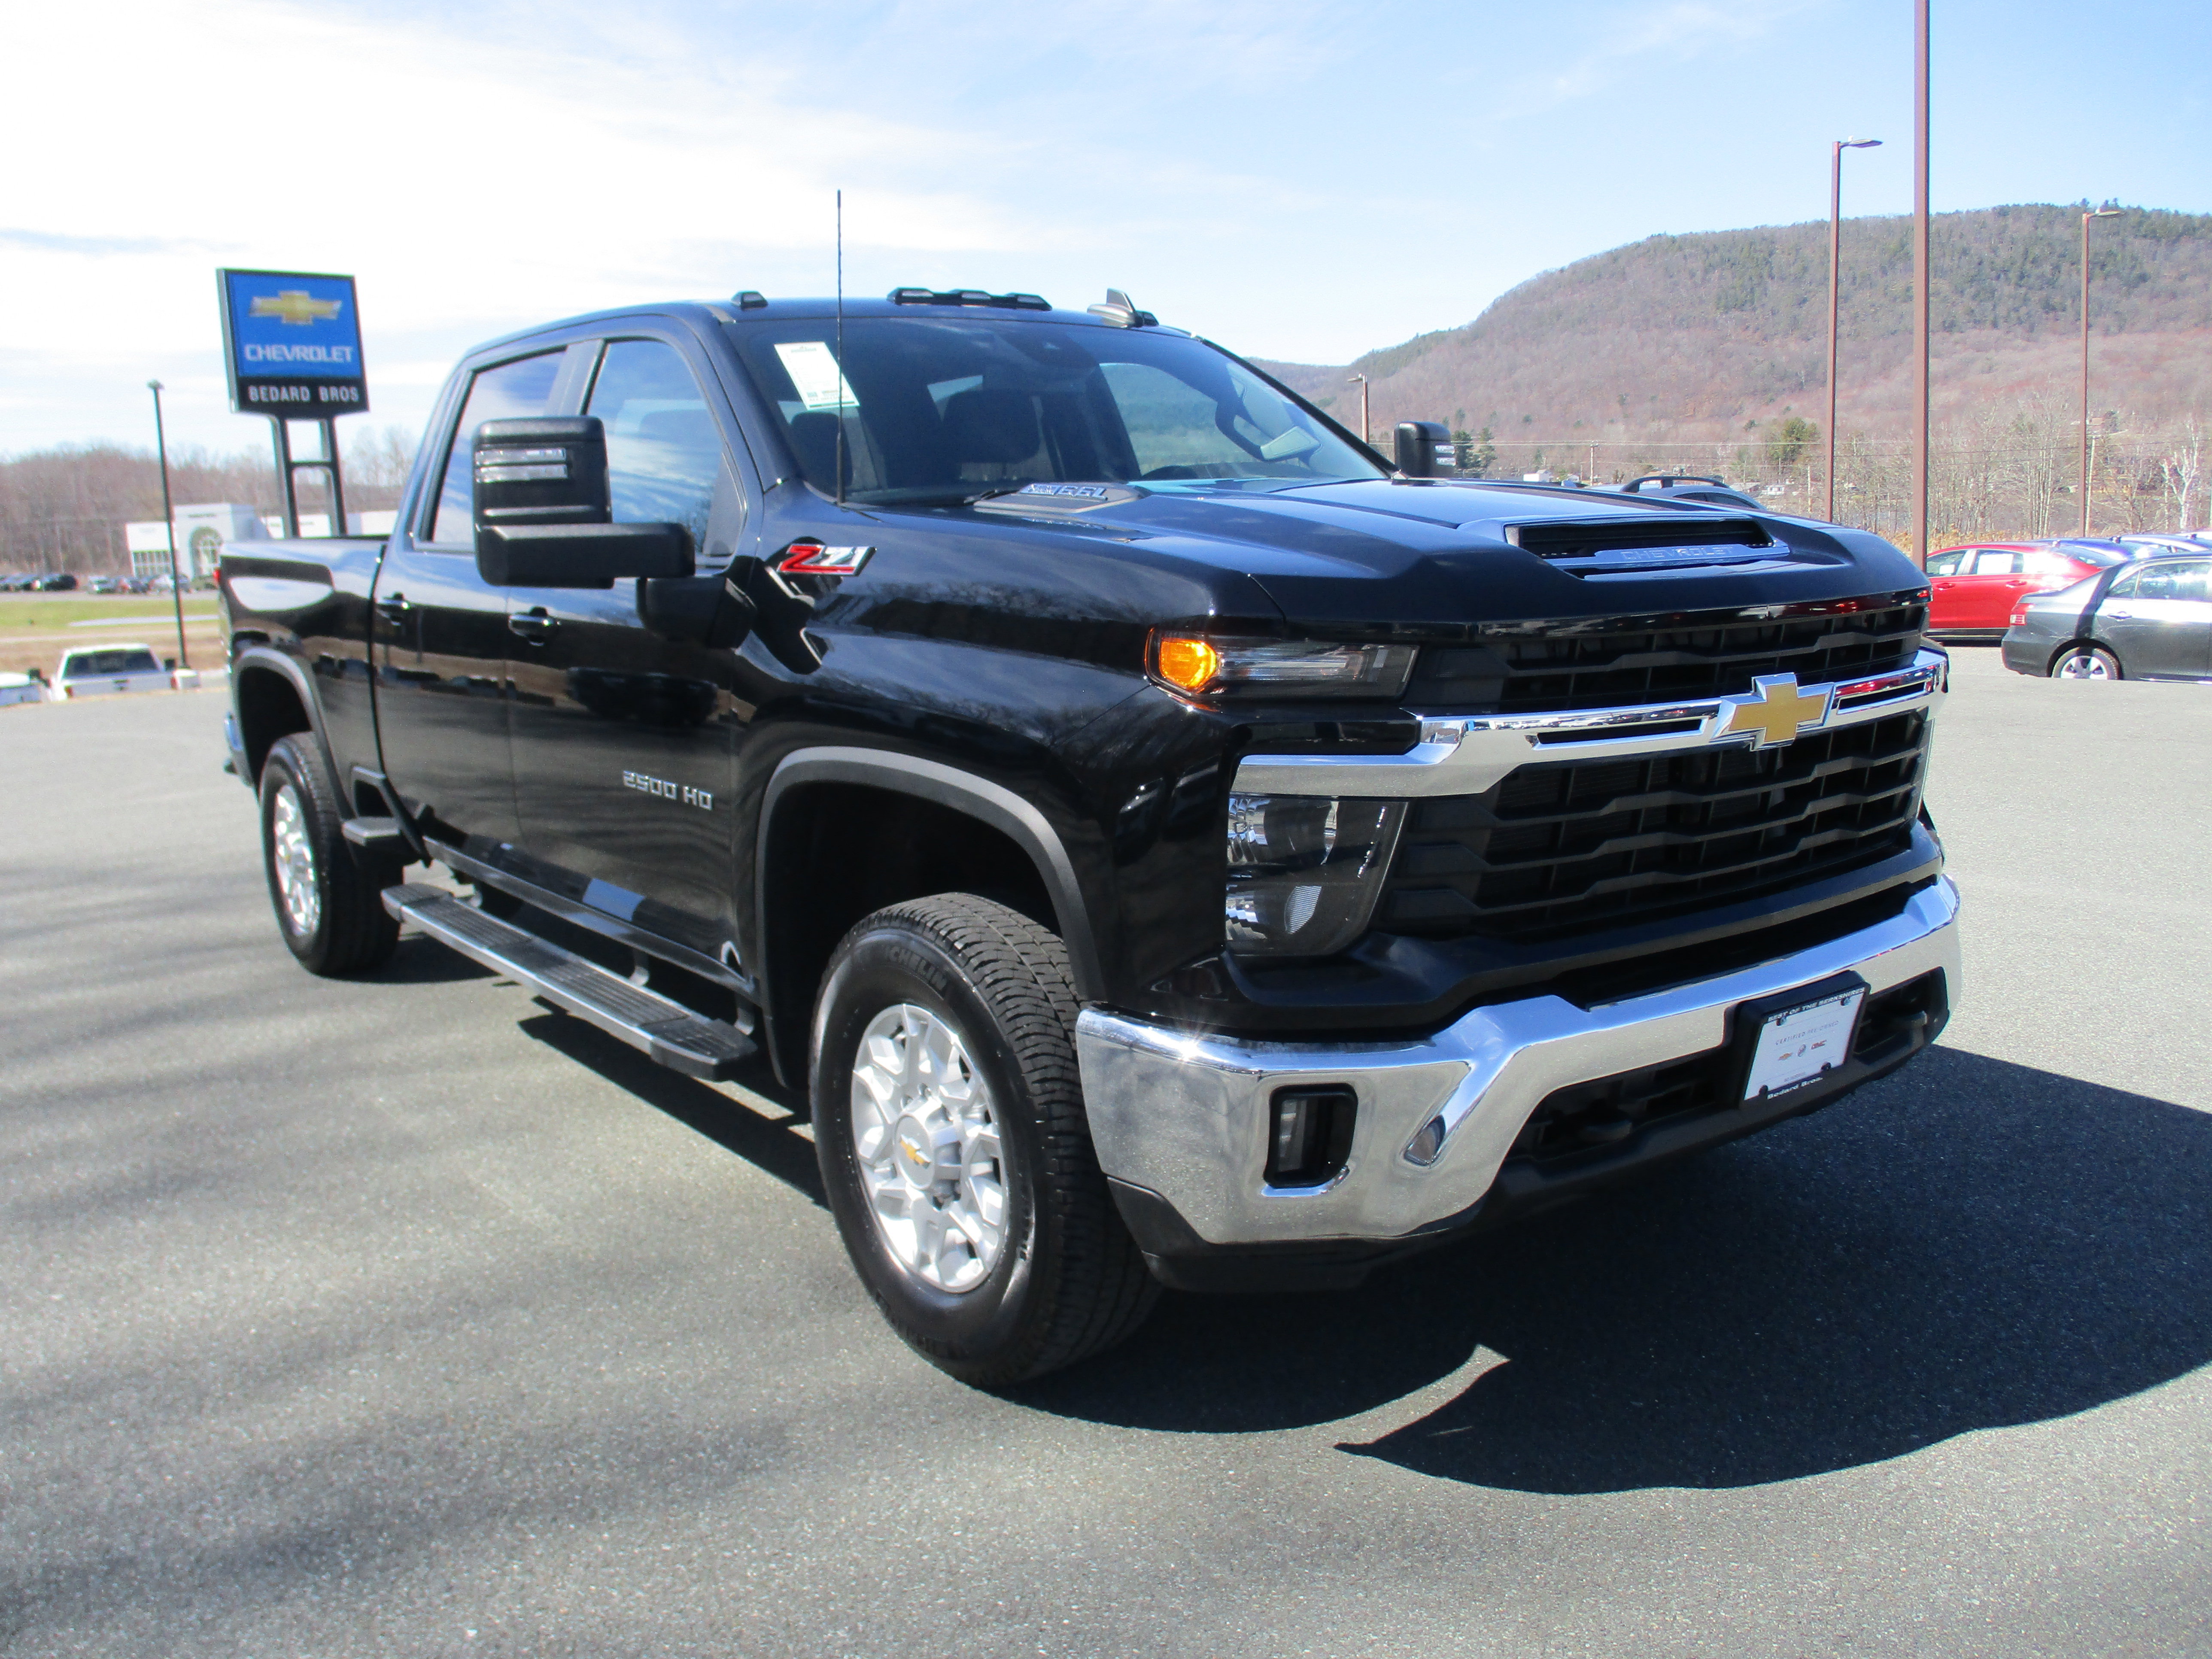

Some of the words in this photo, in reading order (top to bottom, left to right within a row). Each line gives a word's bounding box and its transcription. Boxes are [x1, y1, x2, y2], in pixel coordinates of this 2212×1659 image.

[244, 344, 353, 362] CHEVROLET
[248, 386, 311, 402] BEDARD
[318, 386, 360, 403] BROS
[776, 543, 873, 575] Z71
[1620, 546, 1733, 560] CHEVROLET
[623, 770, 678, 800] 2500
[682, 786, 714, 811] HD
